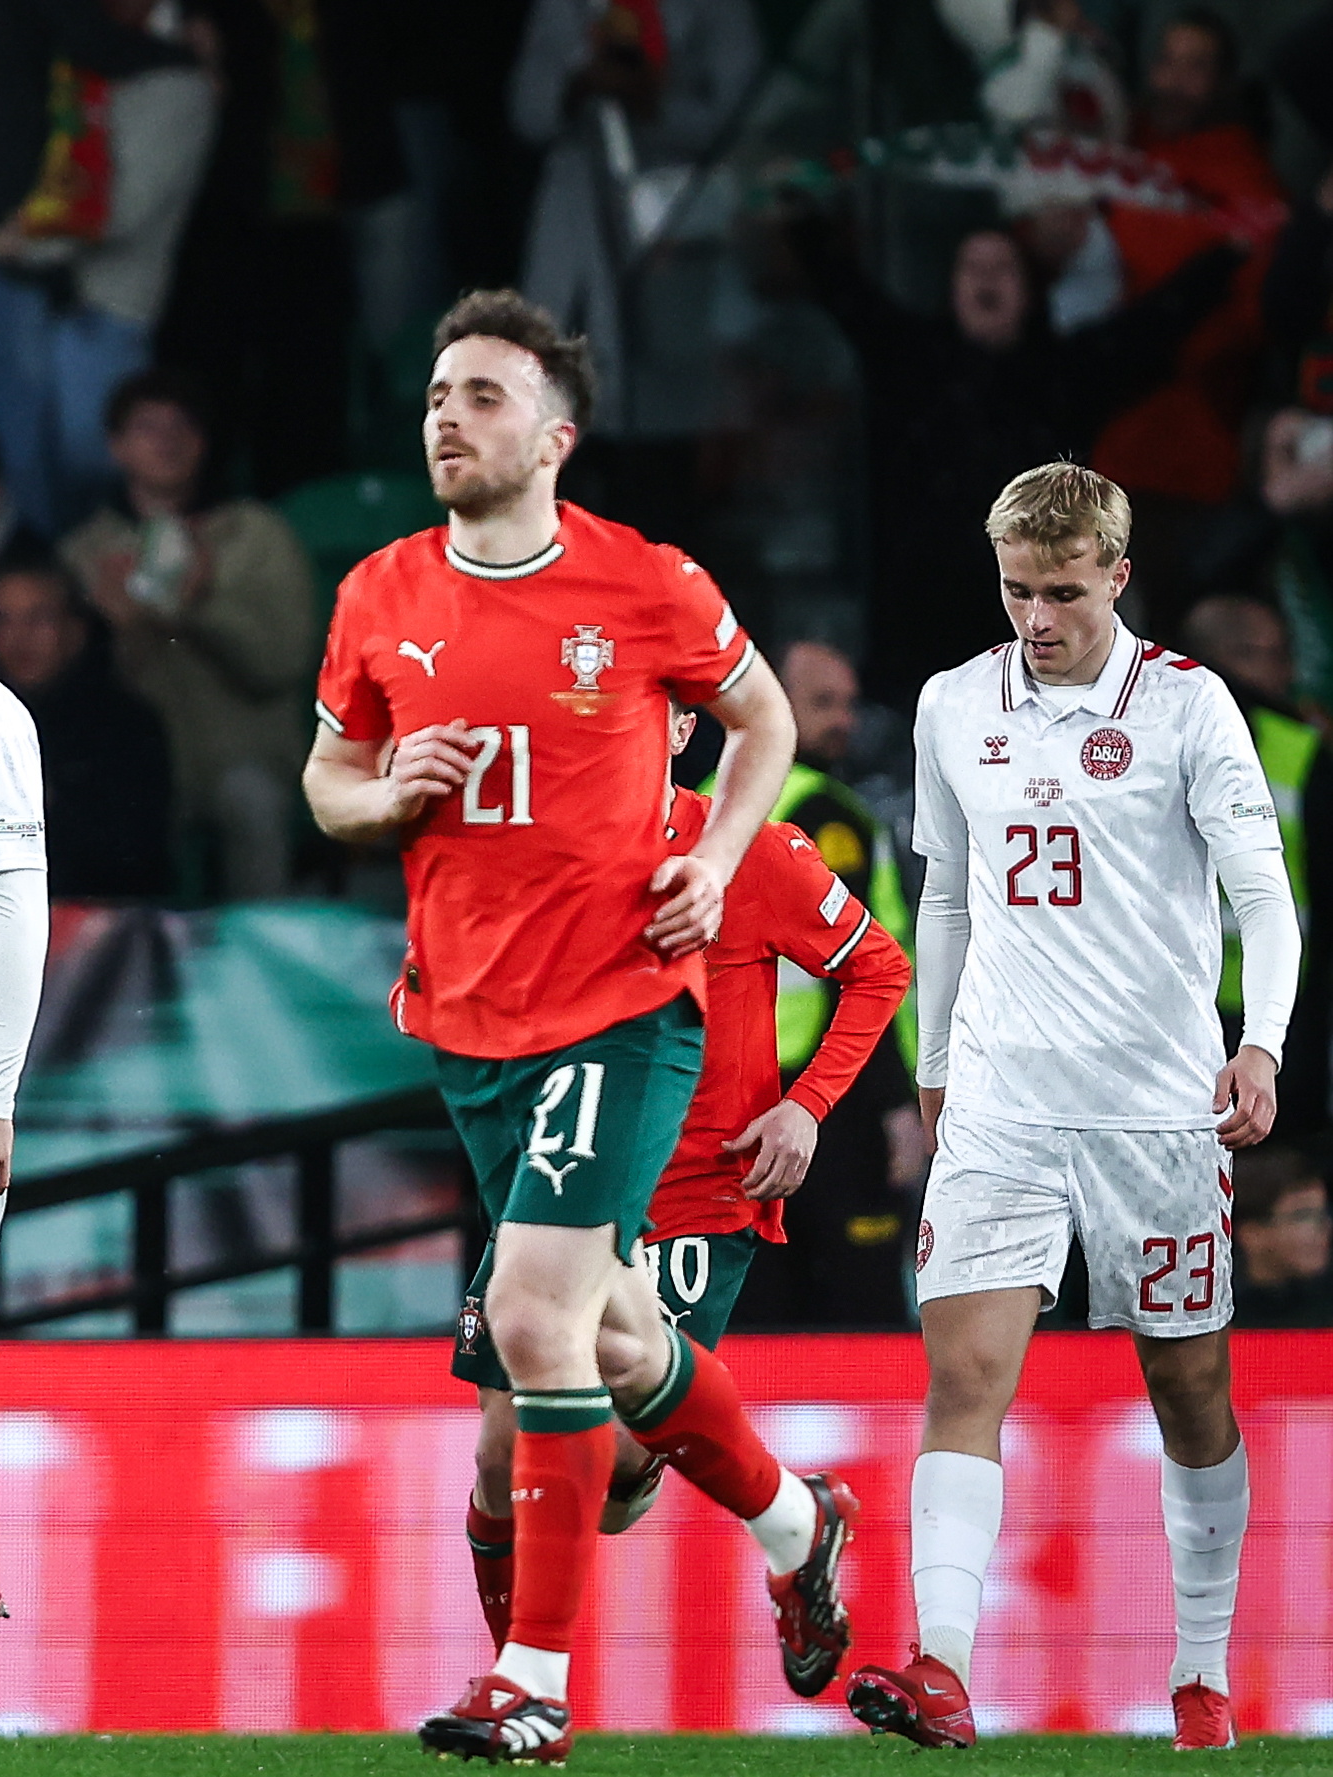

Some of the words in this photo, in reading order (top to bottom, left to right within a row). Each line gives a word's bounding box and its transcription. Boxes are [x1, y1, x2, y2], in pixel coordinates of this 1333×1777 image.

[462, 724, 536, 825] 21
[1090, 745, 1123, 762] DBU
[1006, 825, 1083, 907] 23
[527, 1062, 606, 1160] 21
[1138, 1231, 1215, 1313] 23
